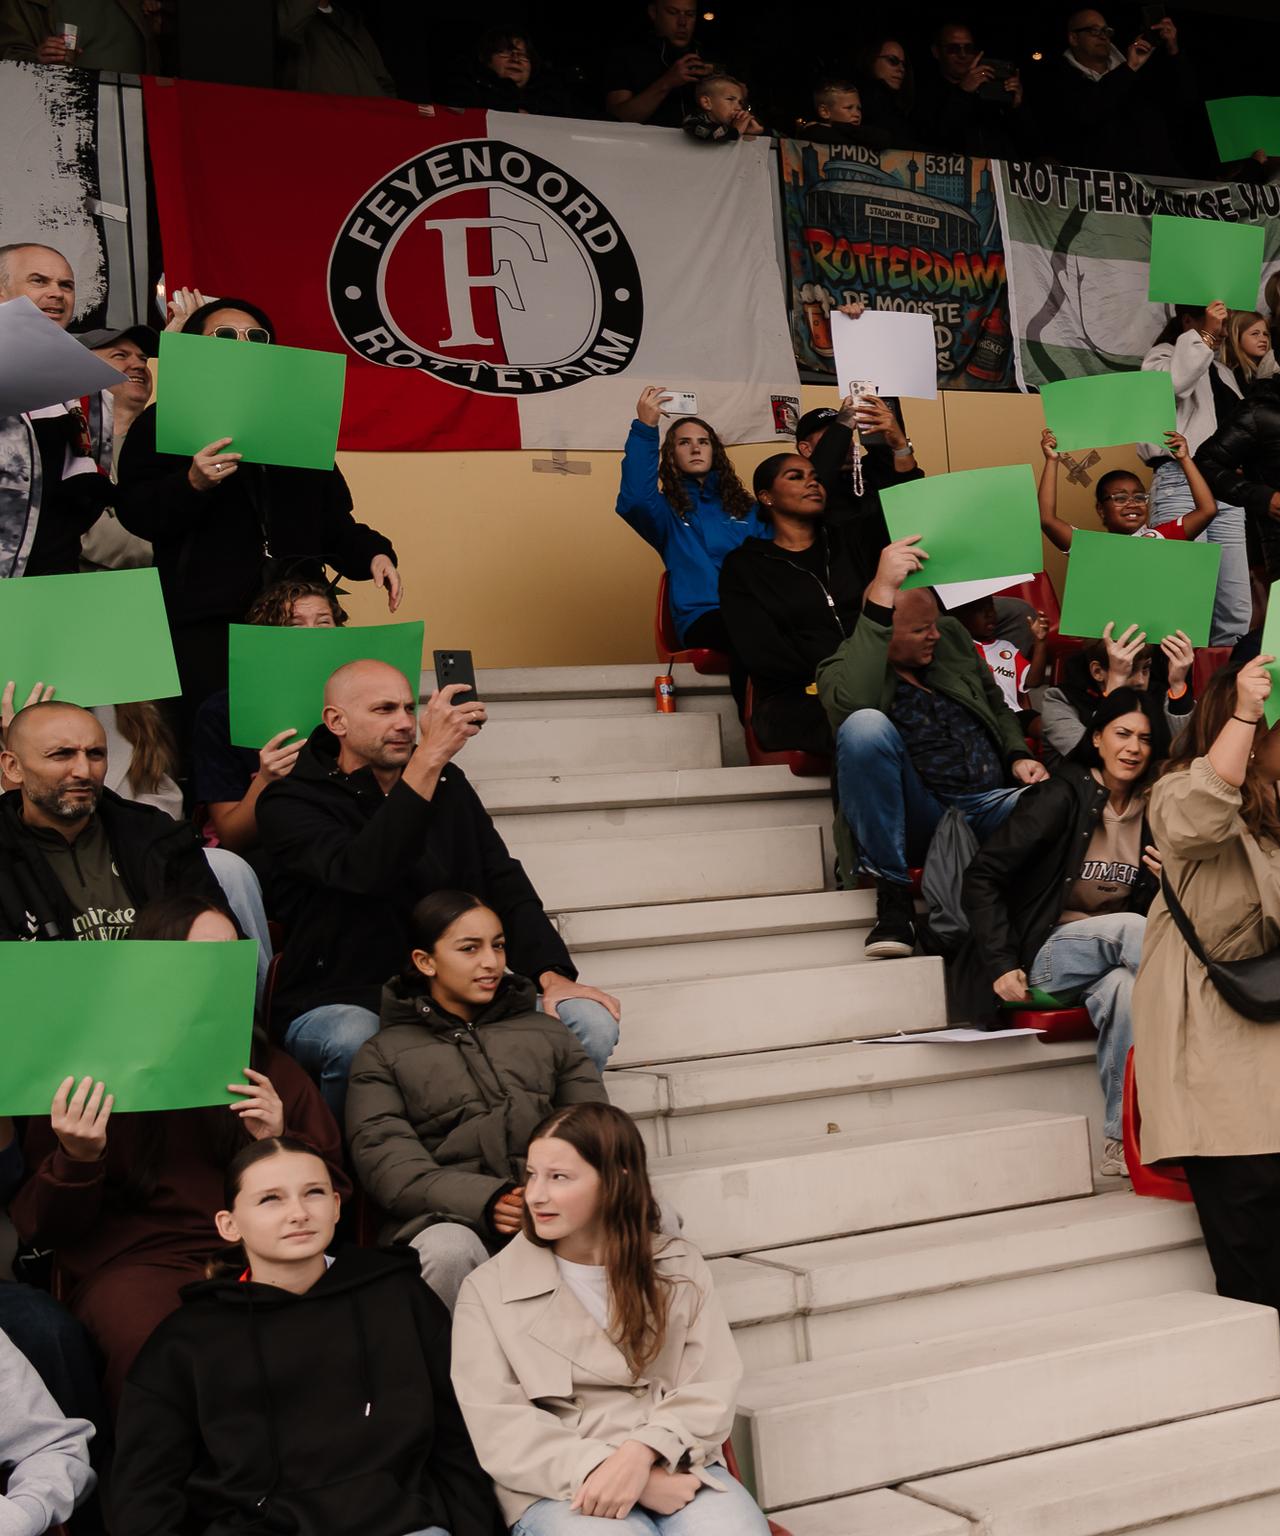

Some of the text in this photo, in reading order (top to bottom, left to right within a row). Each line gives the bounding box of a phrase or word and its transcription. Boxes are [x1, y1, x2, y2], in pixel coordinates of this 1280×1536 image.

[831, 144, 881, 166] PMDS
[925, 154, 965, 175] 5314
[348, 146, 619, 253] FEYENOORD
[869, 207, 937, 226] STADION DE KUIP
[425, 216, 548, 348] F
[803, 227, 1007, 299] ROTTERDAM
[354, 326, 635, 388] ROTTERDAM
